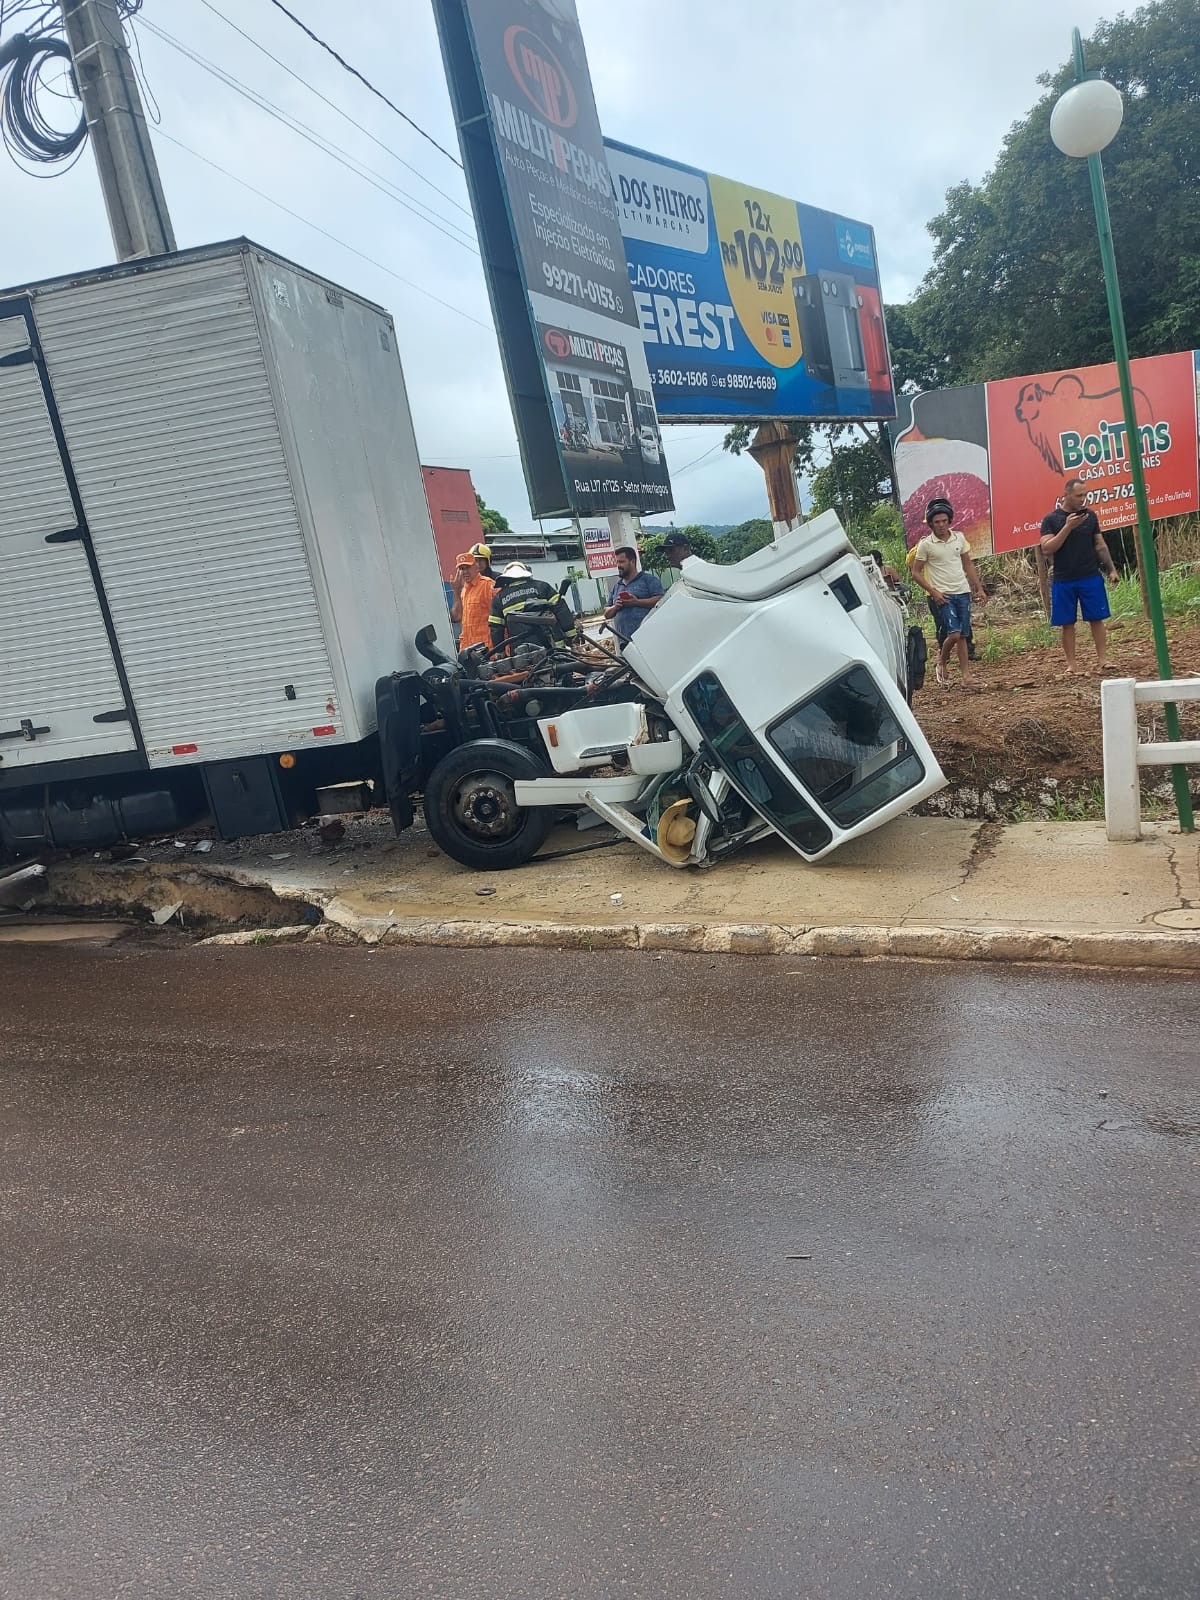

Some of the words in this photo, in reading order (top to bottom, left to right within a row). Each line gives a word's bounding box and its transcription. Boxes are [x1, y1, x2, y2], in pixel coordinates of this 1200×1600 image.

[619, 174, 652, 210] DOS
[652, 185, 705, 225] FILTROS
[528, 192, 595, 243] Especializada
[596, 232, 611, 251] em
[616, 206, 690, 234] LTIMARCAS
[734, 228, 803, 284] 102,00
[542, 262, 616, 313] 99271-0153
[632, 291, 735, 351] EREST
[761, 311, 778, 326] VISA
[658, 369, 708, 387] 3602-1506
[718, 377, 727, 387] 63
[727, 374, 777, 390] 98502-6689
[1060, 419, 1172, 471] BoiTns
[1079, 466, 1106, 481] CASA
[1107, 462, 1121, 476] DE
[1123, 455, 1161, 473] CNES
[574, 479, 590, 493] Rua
[624, 480, 640, 493] Setor
[1082, 483, 1136, 507] 973-762
[1024, 520, 1042, 531] Caste
